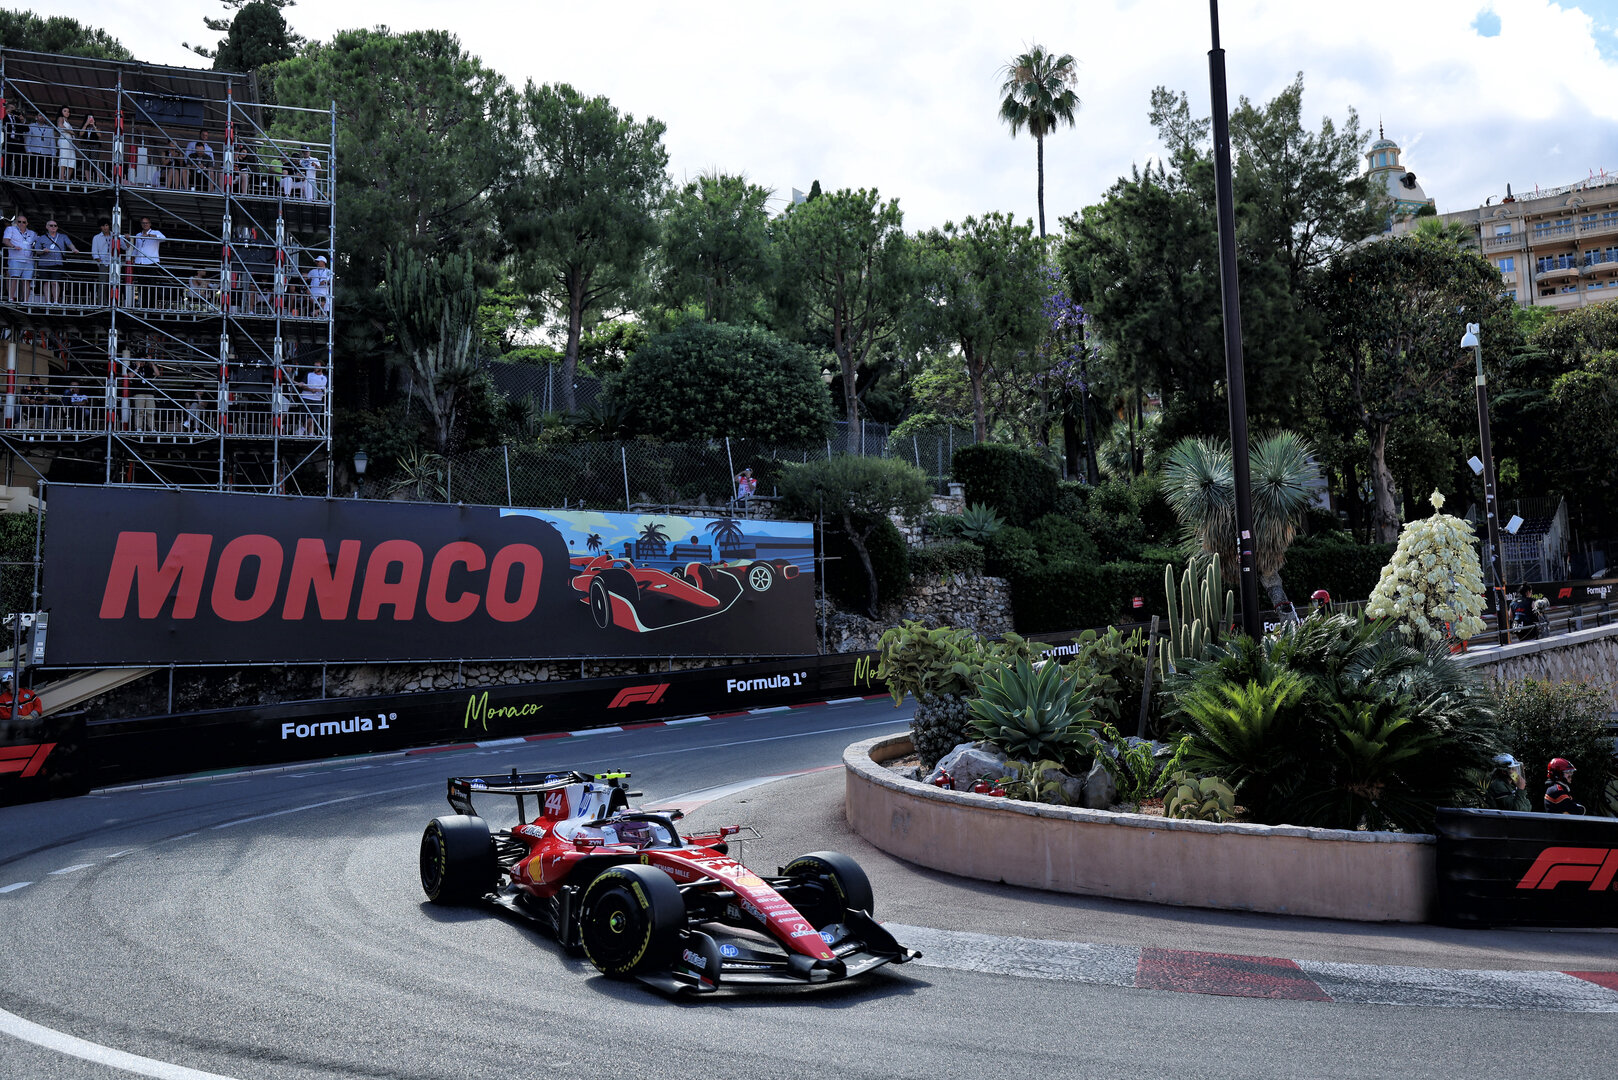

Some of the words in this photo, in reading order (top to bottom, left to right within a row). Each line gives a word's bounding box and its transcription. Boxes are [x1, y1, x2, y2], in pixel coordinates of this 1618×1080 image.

[99, 531, 544, 622] MONACO
[1040, 642, 1082, 657] ormul
[726, 674, 791, 693] Formula
[464, 691, 544, 732] Monaco
[281, 716, 373, 740] Formula
[545, 792, 563, 816] 44
[674, 869, 690, 879] MILLE
[722, 945, 737, 957] hp
